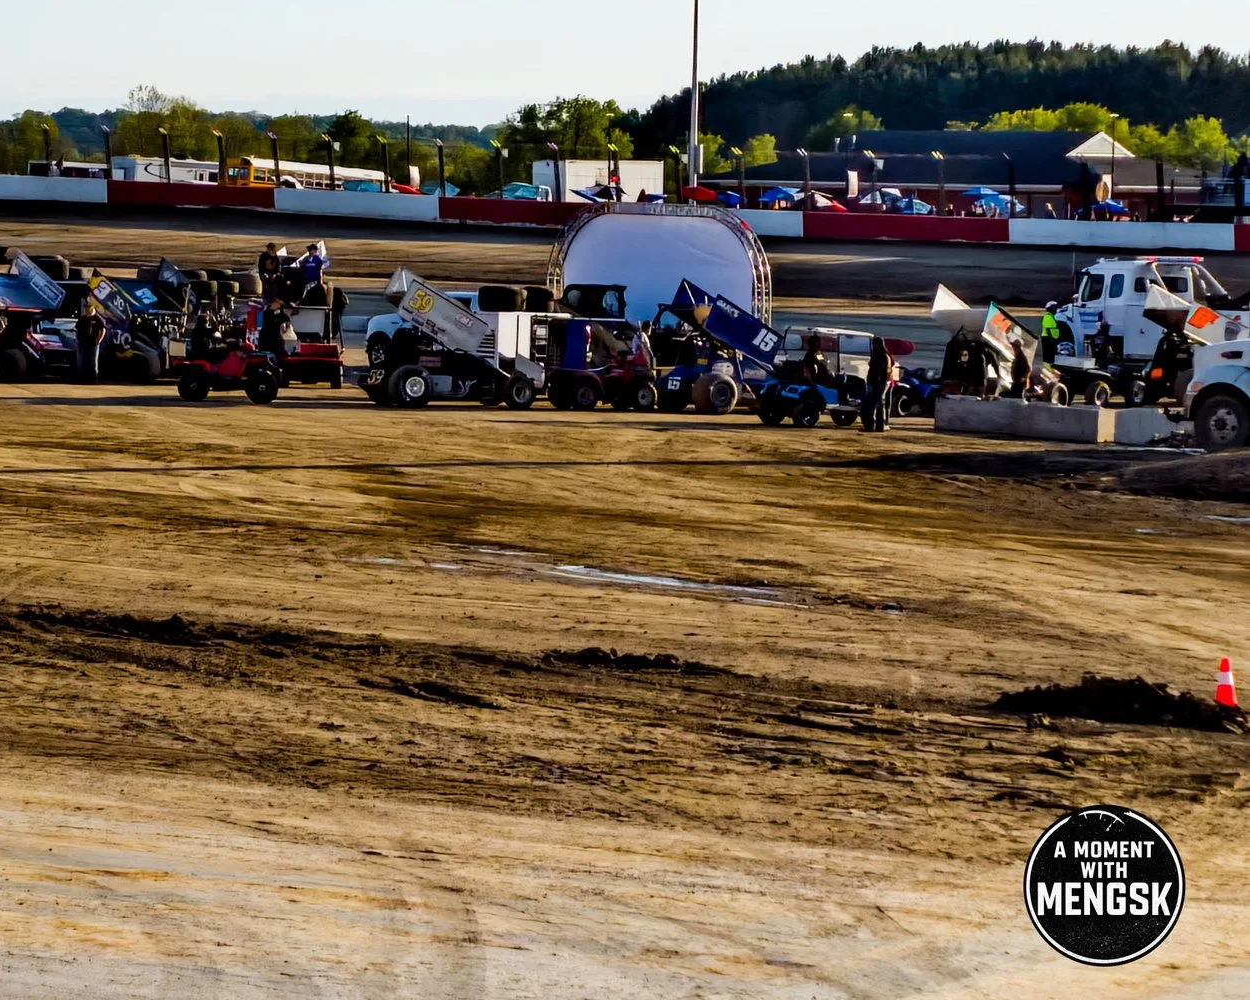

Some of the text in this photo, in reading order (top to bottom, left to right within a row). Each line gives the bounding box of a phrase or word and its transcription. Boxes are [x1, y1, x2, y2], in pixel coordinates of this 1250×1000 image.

[409, 289, 435, 314] 59
[752, 328, 779, 352] 15
[367, 369, 385, 385] 59
